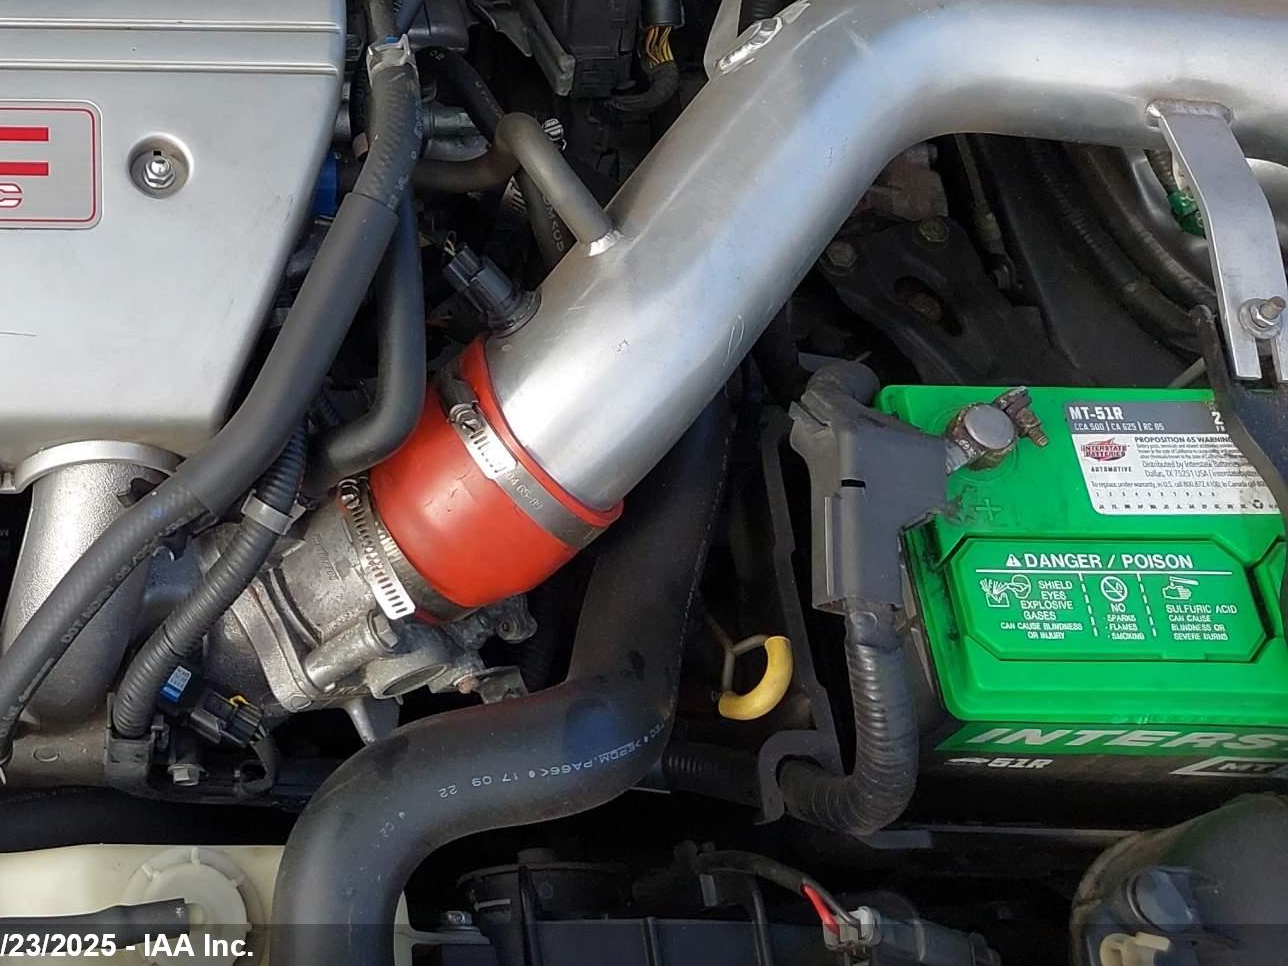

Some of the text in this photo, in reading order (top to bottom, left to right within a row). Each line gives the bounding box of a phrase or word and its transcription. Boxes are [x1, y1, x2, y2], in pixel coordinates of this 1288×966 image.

[1069, 406, 1125, 421] MT-51R
[1074, 422, 1090, 431] CCA
[1090, 422, 1105, 431] 500
[1111, 422, 1122, 431] CA
[1143, 422, 1154, 431] RC
[1081, 444, 1128, 452] INTERSTATE
[1142, 460, 1175, 468] Distributed
[1176, 460, 1184, 470] by
[1174, 470, 1193, 478] 75251
[1196, 470, 1209, 478] USA
[1023, 553, 1194, 569] DANGER / POISON
[1038, 580, 1073, 590] SHIELD
[1041, 591, 1067, 600] EYES
[1020, 600, 1074, 610] EXPLOSIVE
[1111, 602, 1126, 613] NO
[1165, 604, 1238, 614] SULFURIC ACID
[1023, 610, 1057, 621] GASES
[1107, 614, 1137, 622] SPARKS
[1168, 614, 1212, 623] CAN CAUSE
[1000, 622, 1083, 631] CAN CAUSE BLINDNESS
[1109, 623, 1139, 631] FLAMES
[1171, 623, 1226, 632] BLINDNESS OR
[1027, 631, 1065, 640] OR INJURY
[1111, 632, 1145, 640] SMOKING
[1173, 632, 1202, 641] SEVERE
[965, 727, 1288, 750] INTERS
[987, 757, 1055, 769] 51R
[438, 784, 459, 799] 22
